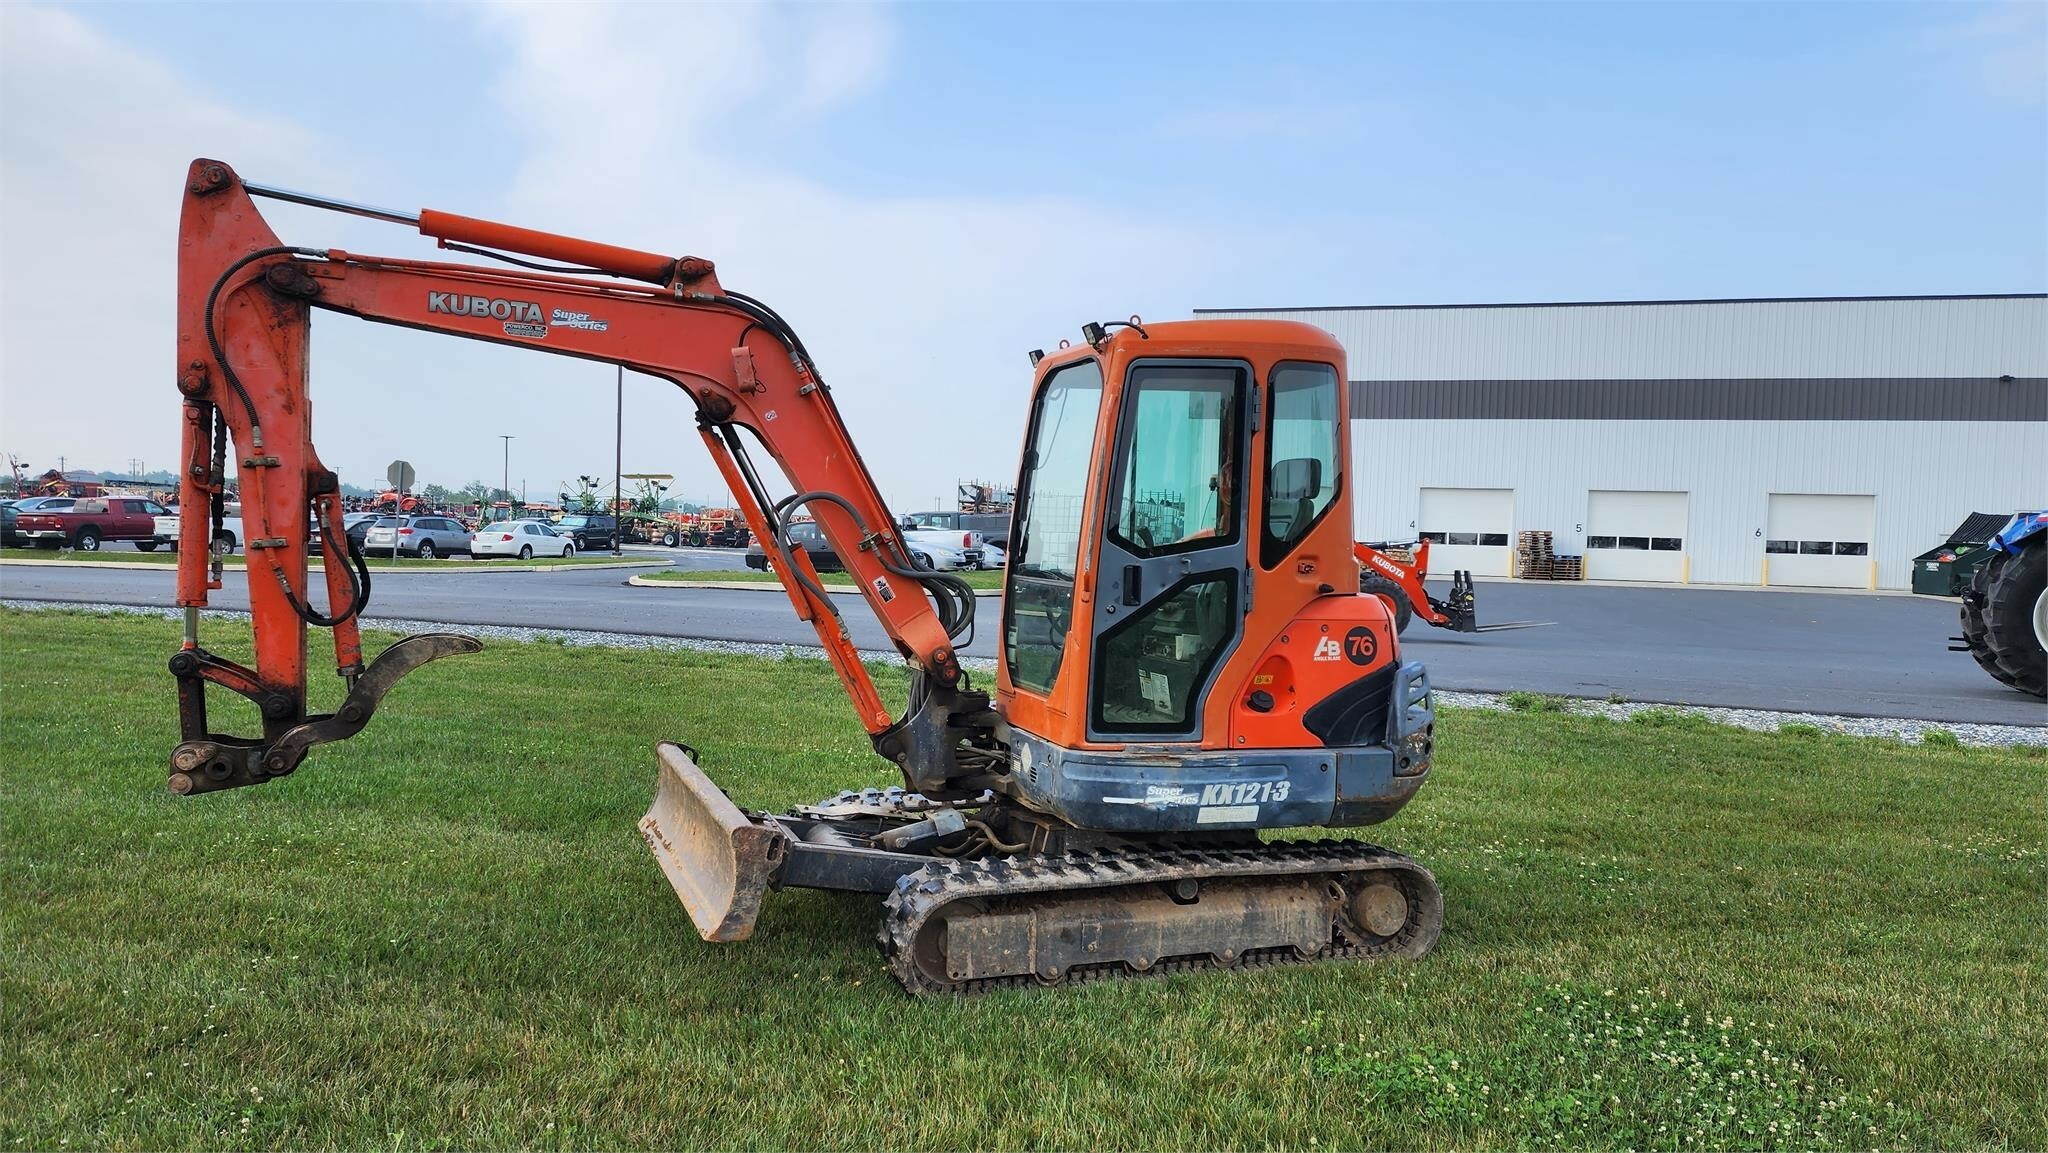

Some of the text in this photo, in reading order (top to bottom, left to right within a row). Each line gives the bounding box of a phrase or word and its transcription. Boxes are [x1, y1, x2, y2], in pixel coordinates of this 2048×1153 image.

[429, 291, 546, 324] KUBOTA
[552, 309, 590, 321] Super
[569, 320, 608, 331] Series
[1409, 520, 1415, 528] 4
[1576, 523, 1582, 532] 5
[1755, 527, 1761, 537] 6
[1371, 555, 1405, 579] KUBOTA
[1313, 636, 1341, 657] AB
[1348, 635, 1375, 656] 76
[1146, 785, 1184, 797] Super
[1200, 781, 1291, 806] KX121-3
